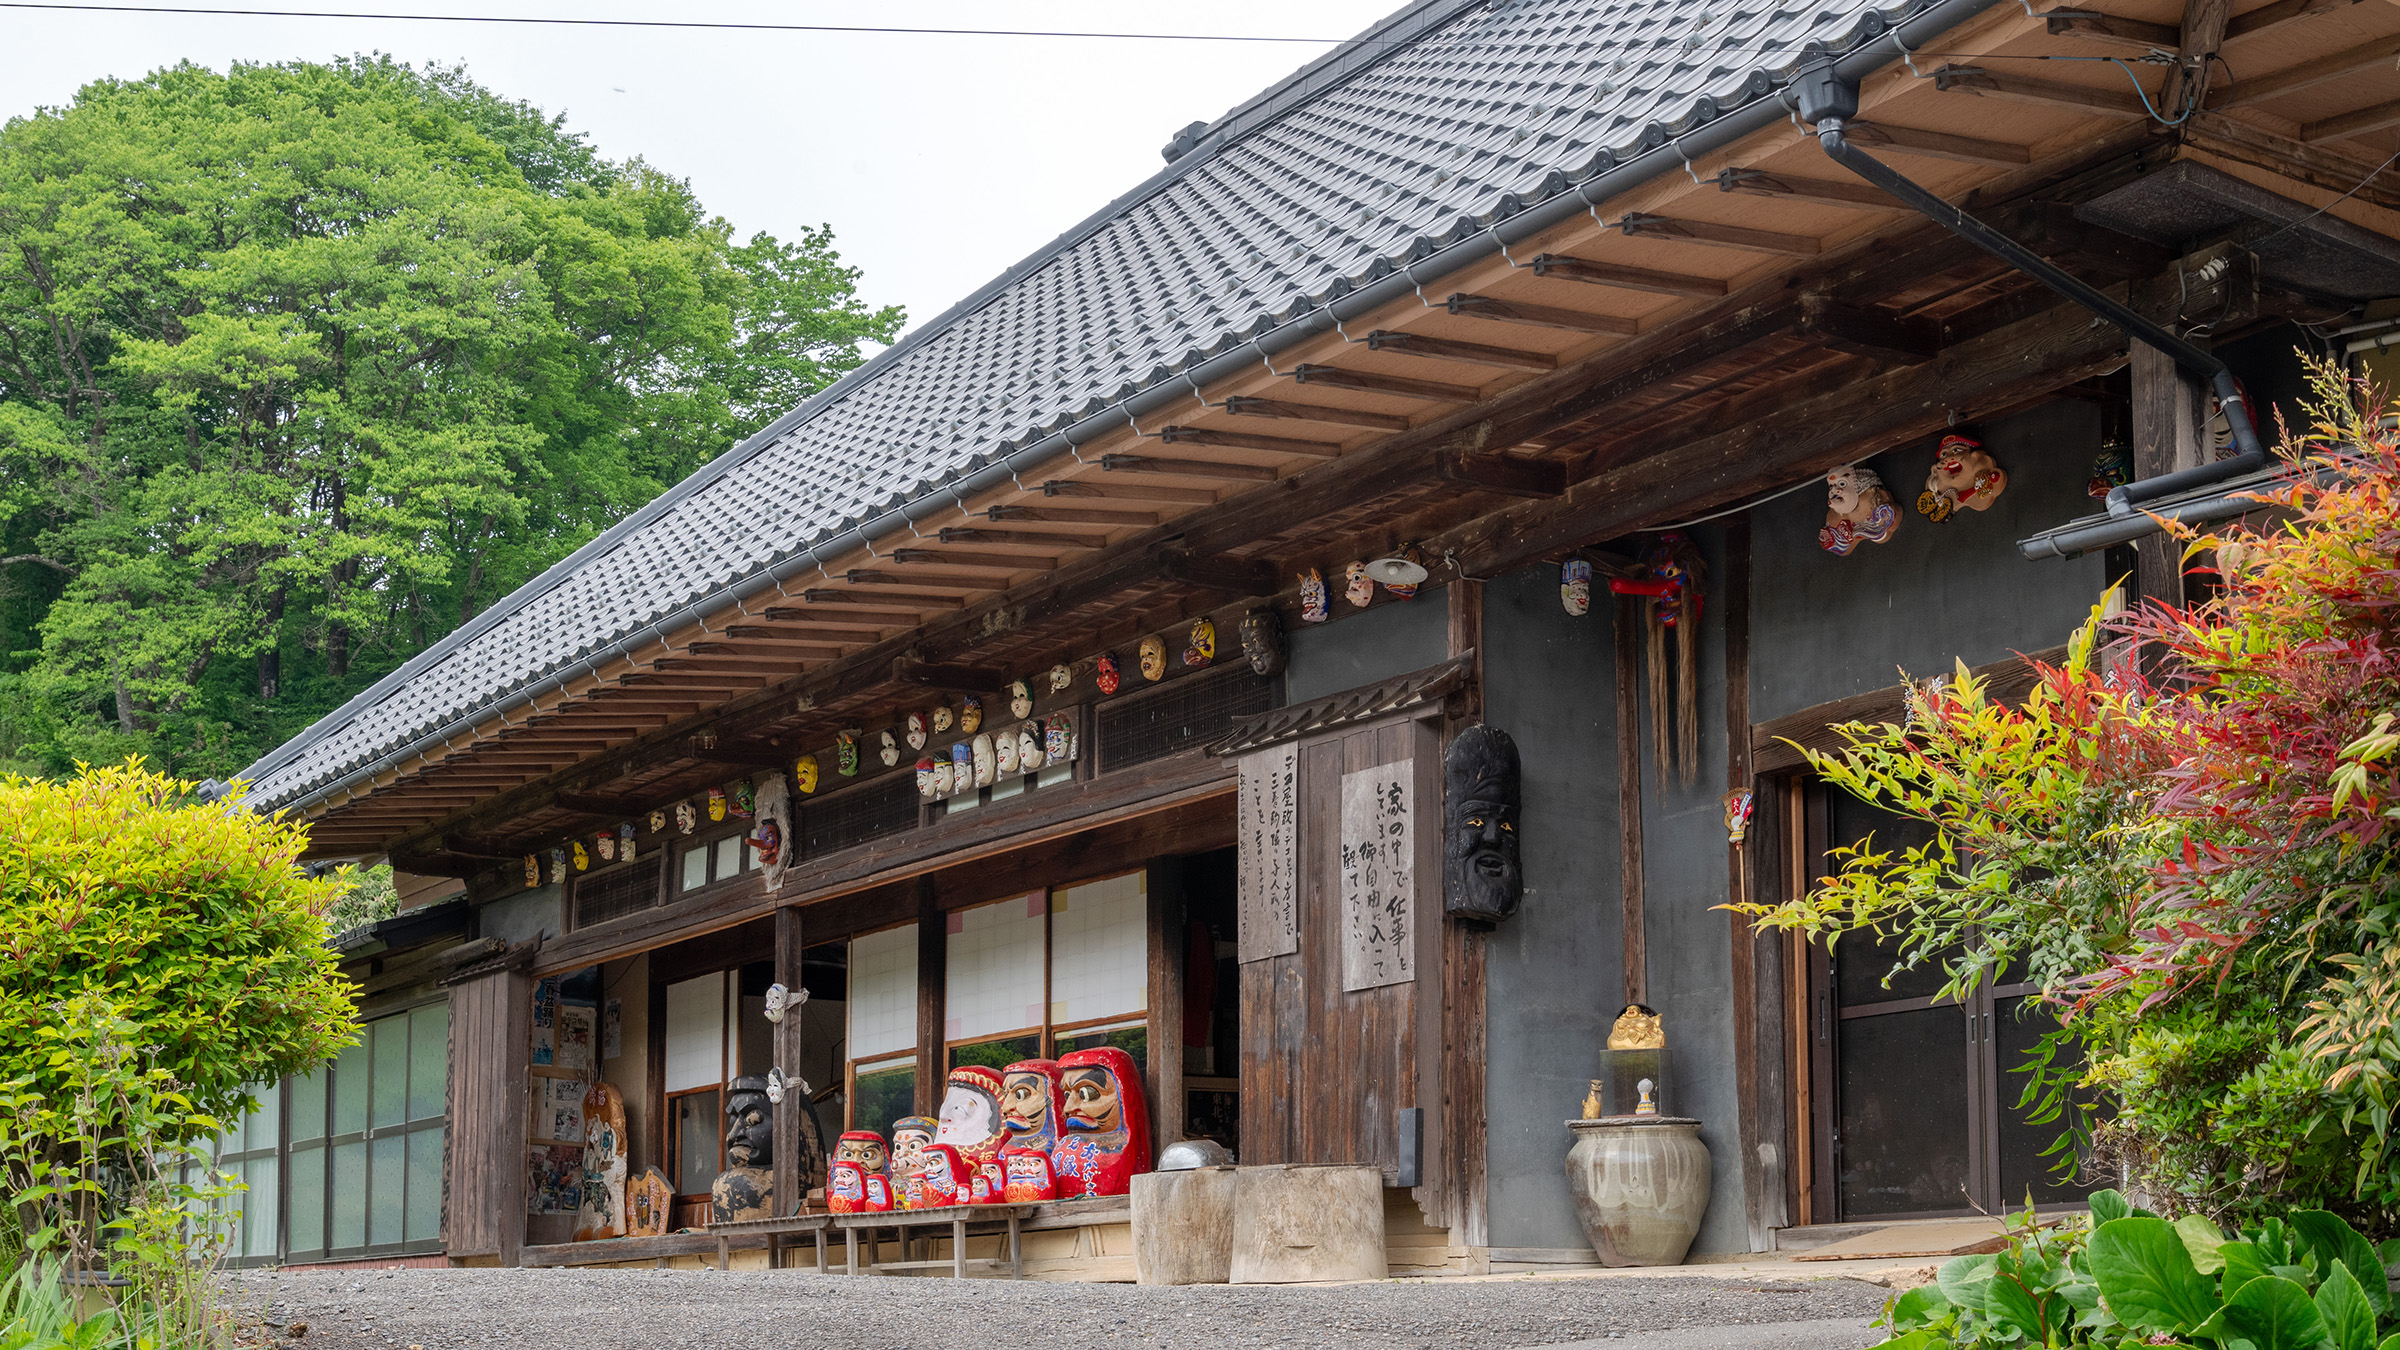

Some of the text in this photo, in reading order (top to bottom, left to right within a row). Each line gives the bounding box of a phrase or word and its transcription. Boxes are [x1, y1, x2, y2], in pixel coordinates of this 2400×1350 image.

[1359, 840, 1385, 978] 御自由に入って
[1386, 781, 1407, 971] 家の中で仕事を
[543, 975, 555, 1029] 三春盆踊り
